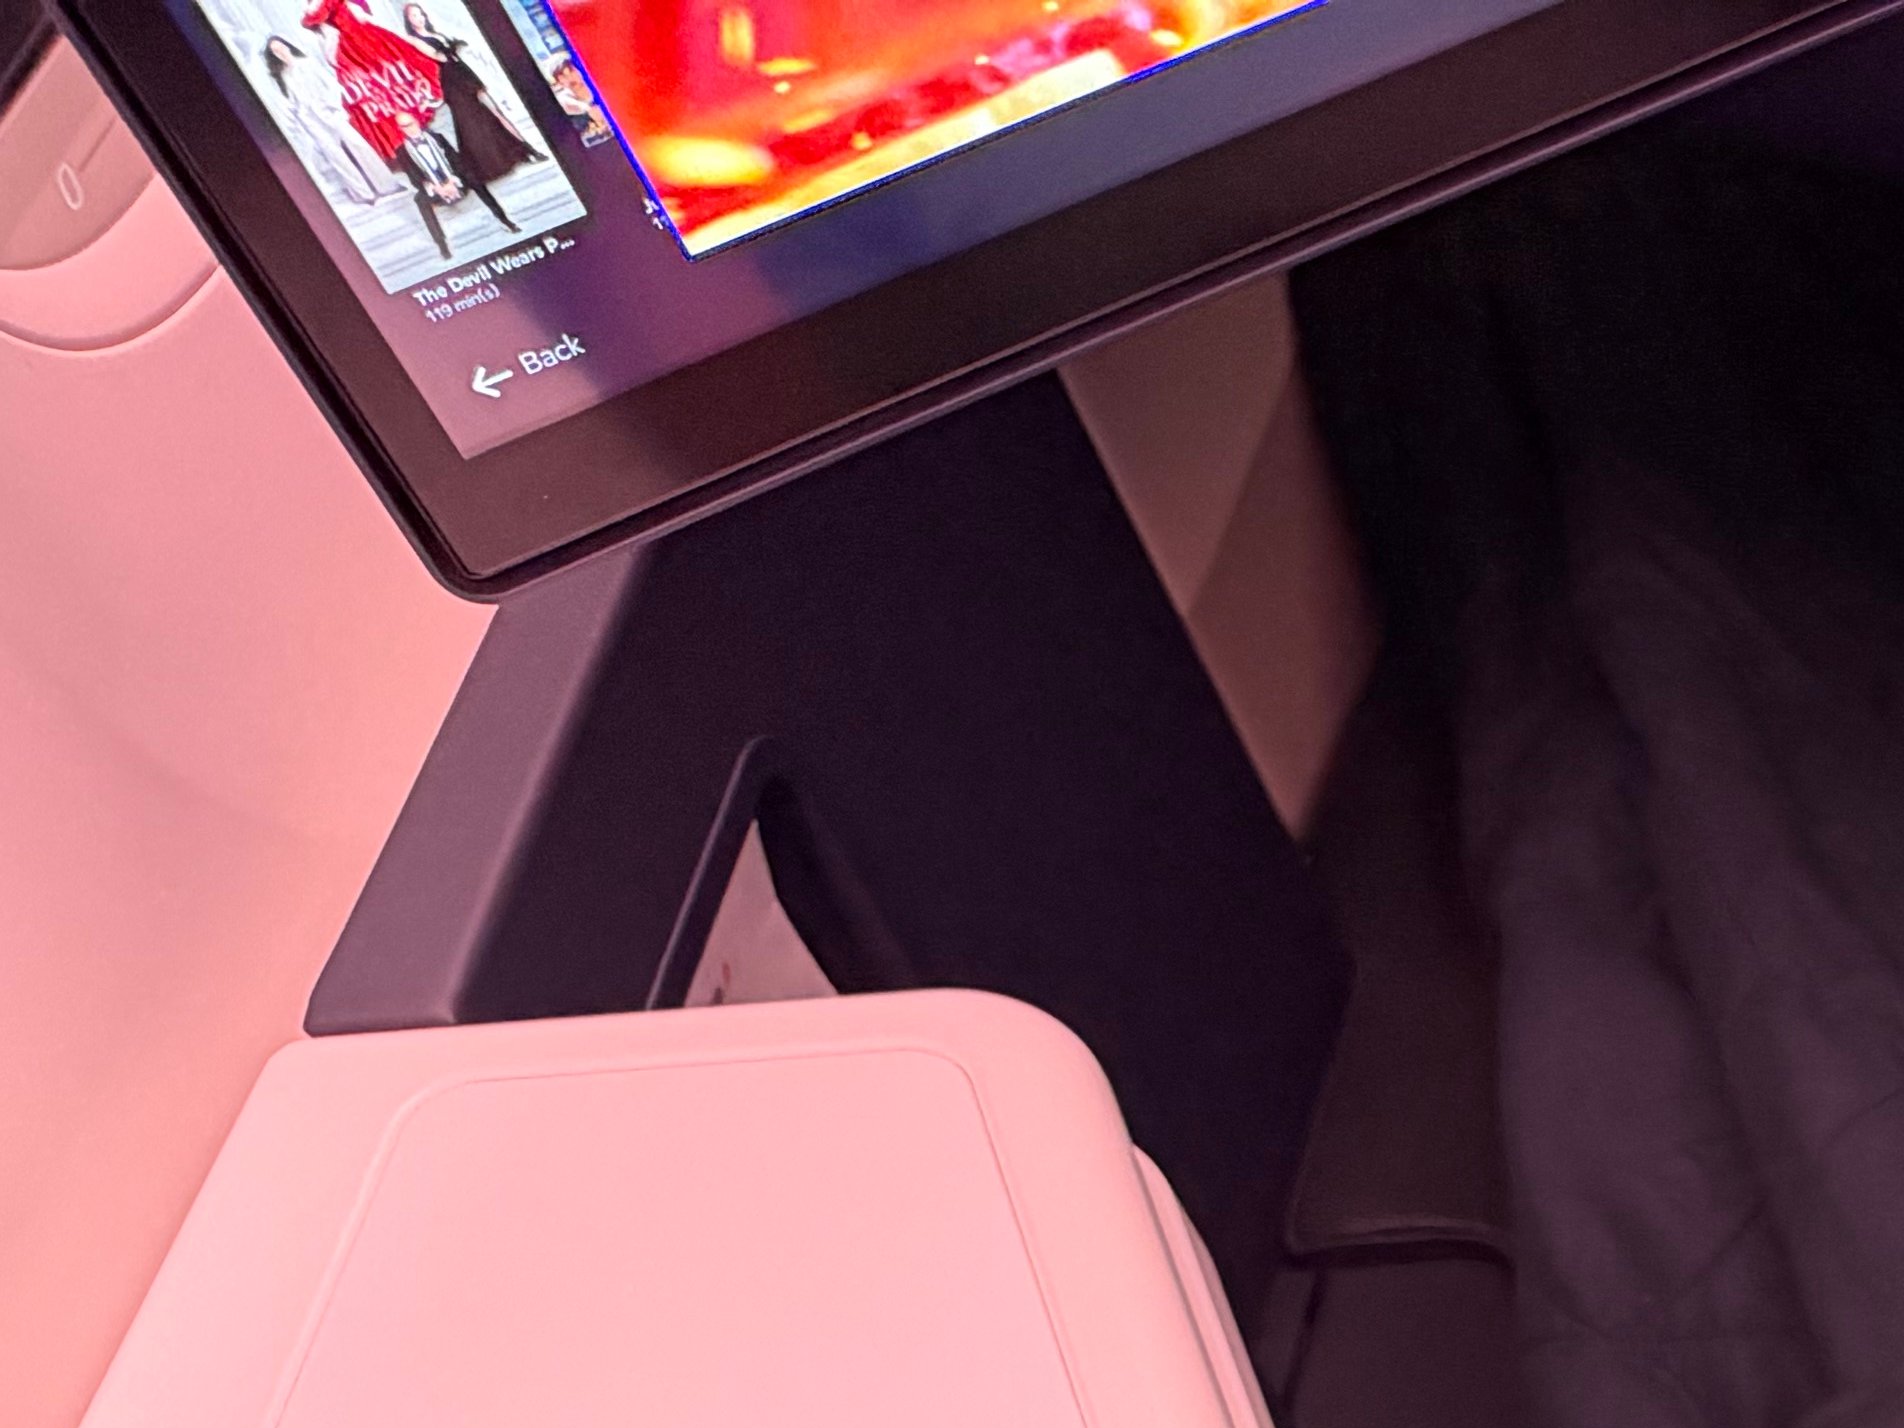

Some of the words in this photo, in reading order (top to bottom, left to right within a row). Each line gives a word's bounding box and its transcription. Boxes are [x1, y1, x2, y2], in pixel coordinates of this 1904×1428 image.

[412, 286, 448, 307] The
[447, 264, 492, 293] Devil
[490, 245, 545, 275] Wears
[425, 303, 454, 323] 119
[454, 283, 500, 312] min(s)
[518, 333, 586, 375] Back
